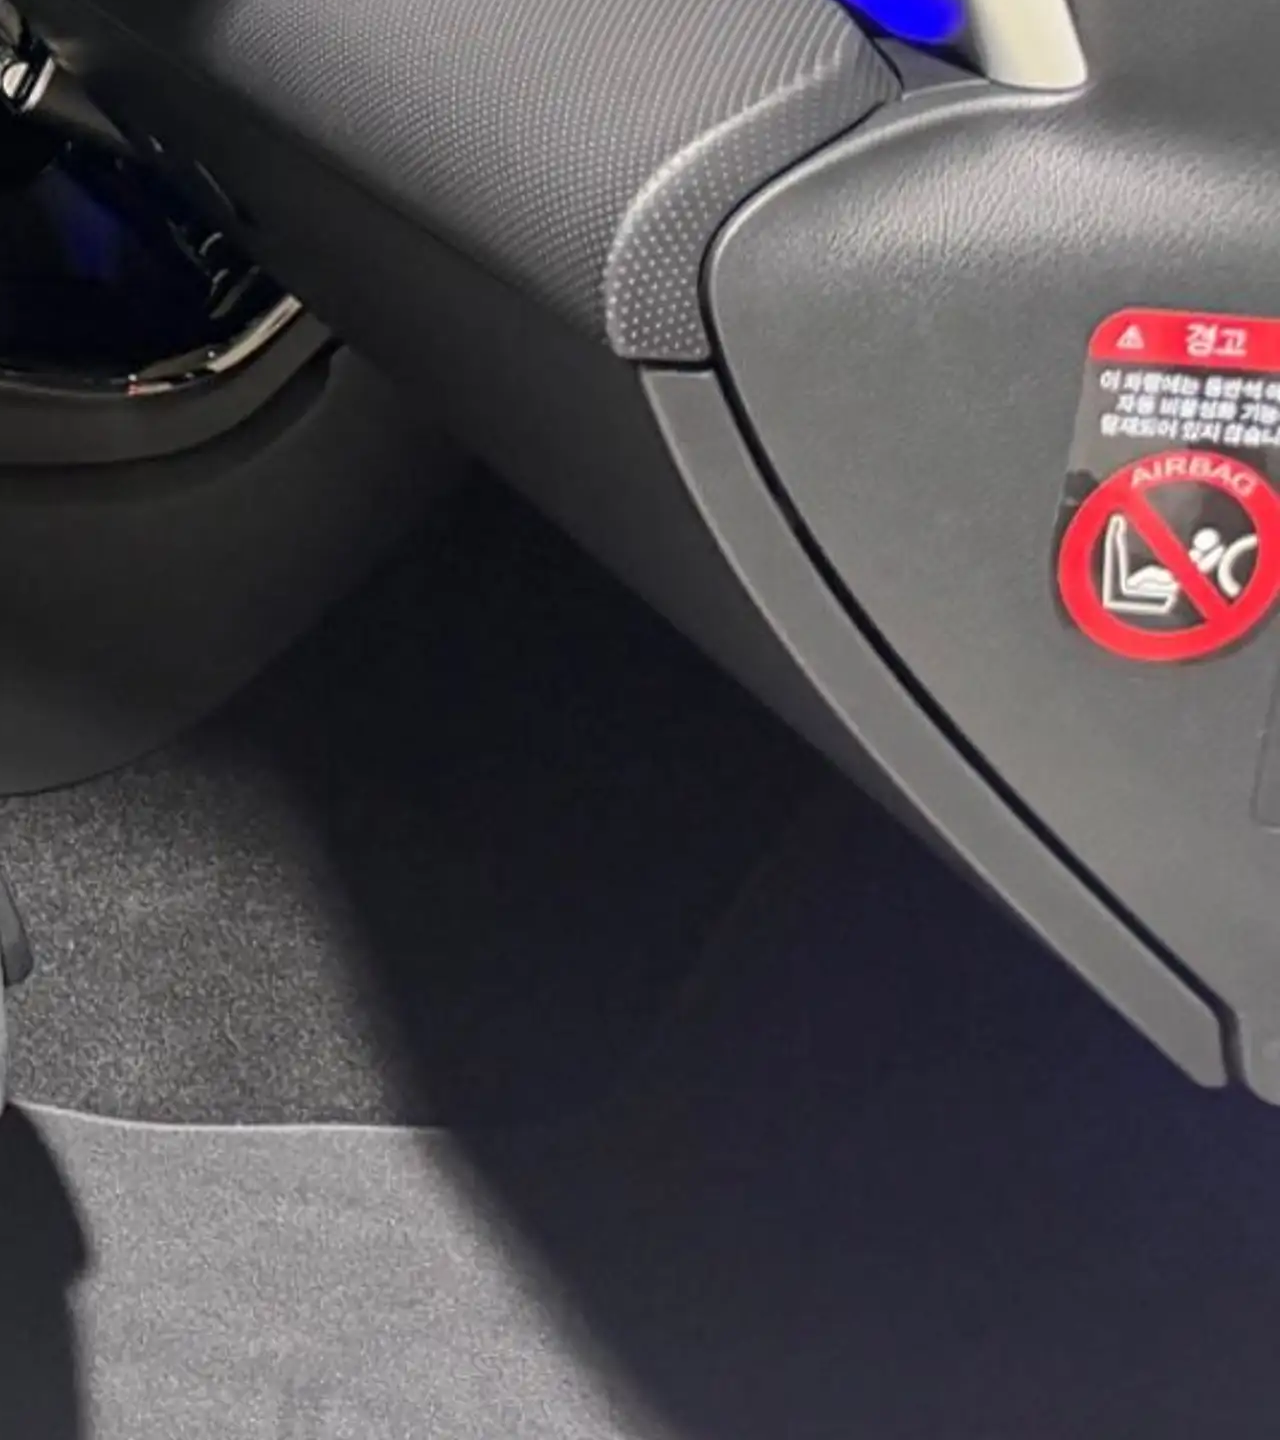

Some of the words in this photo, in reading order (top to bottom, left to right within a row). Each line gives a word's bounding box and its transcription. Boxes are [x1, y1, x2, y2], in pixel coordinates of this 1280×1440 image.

[1187, 323, 1247, 357] 경고
[1100, 369, 1121, 391] 이
[1130, 456, 1257, 497] AIRBAG
